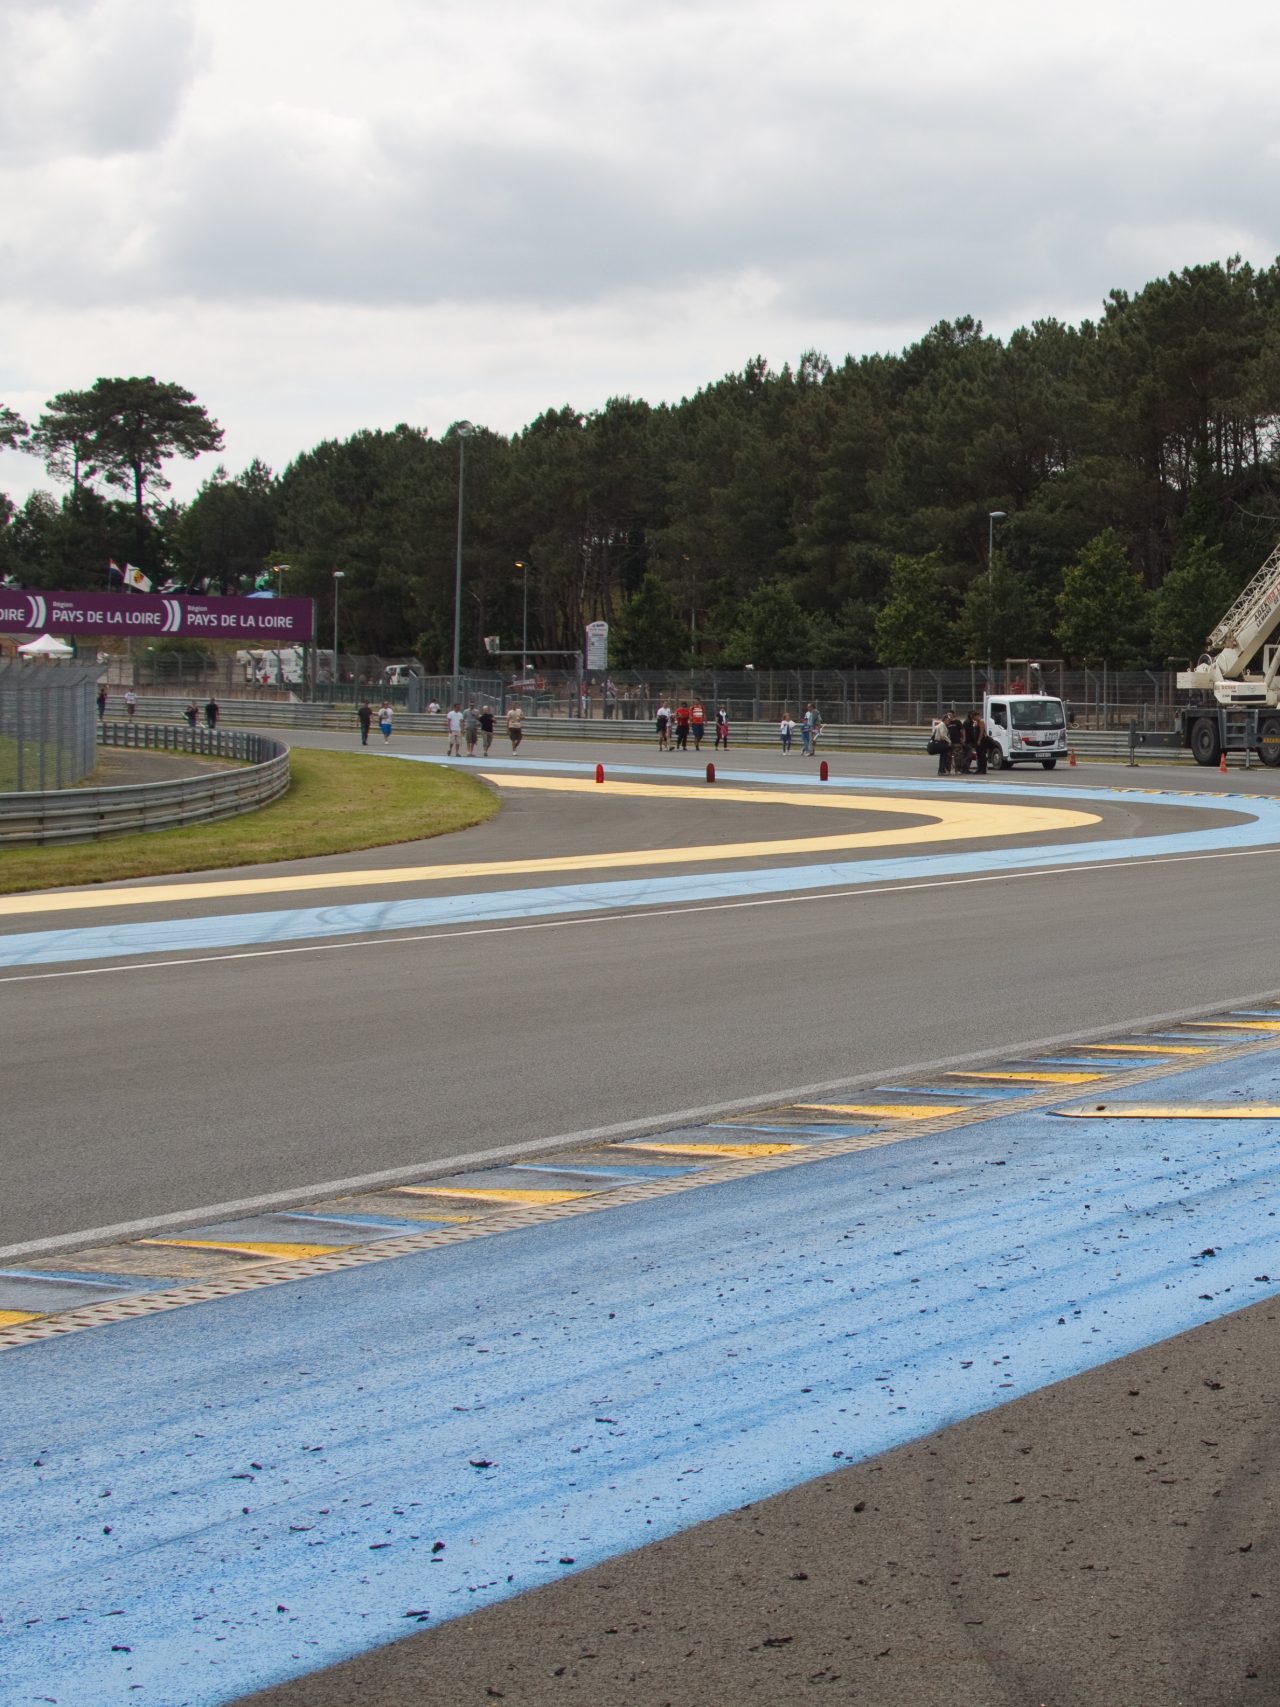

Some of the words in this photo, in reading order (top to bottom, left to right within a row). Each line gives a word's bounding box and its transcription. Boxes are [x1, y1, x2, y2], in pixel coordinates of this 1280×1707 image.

[52, 610, 84, 622] PAYS
[87, 612, 104, 623] DE
[107, 612, 122, 624] LA
[126, 612, 161, 624] LOIRE
[187, 614, 217, 626] PAYS
[221, 615, 237, 626] DE
[240, 616, 256, 627] LA
[258, 616, 293, 628] LOIRE
